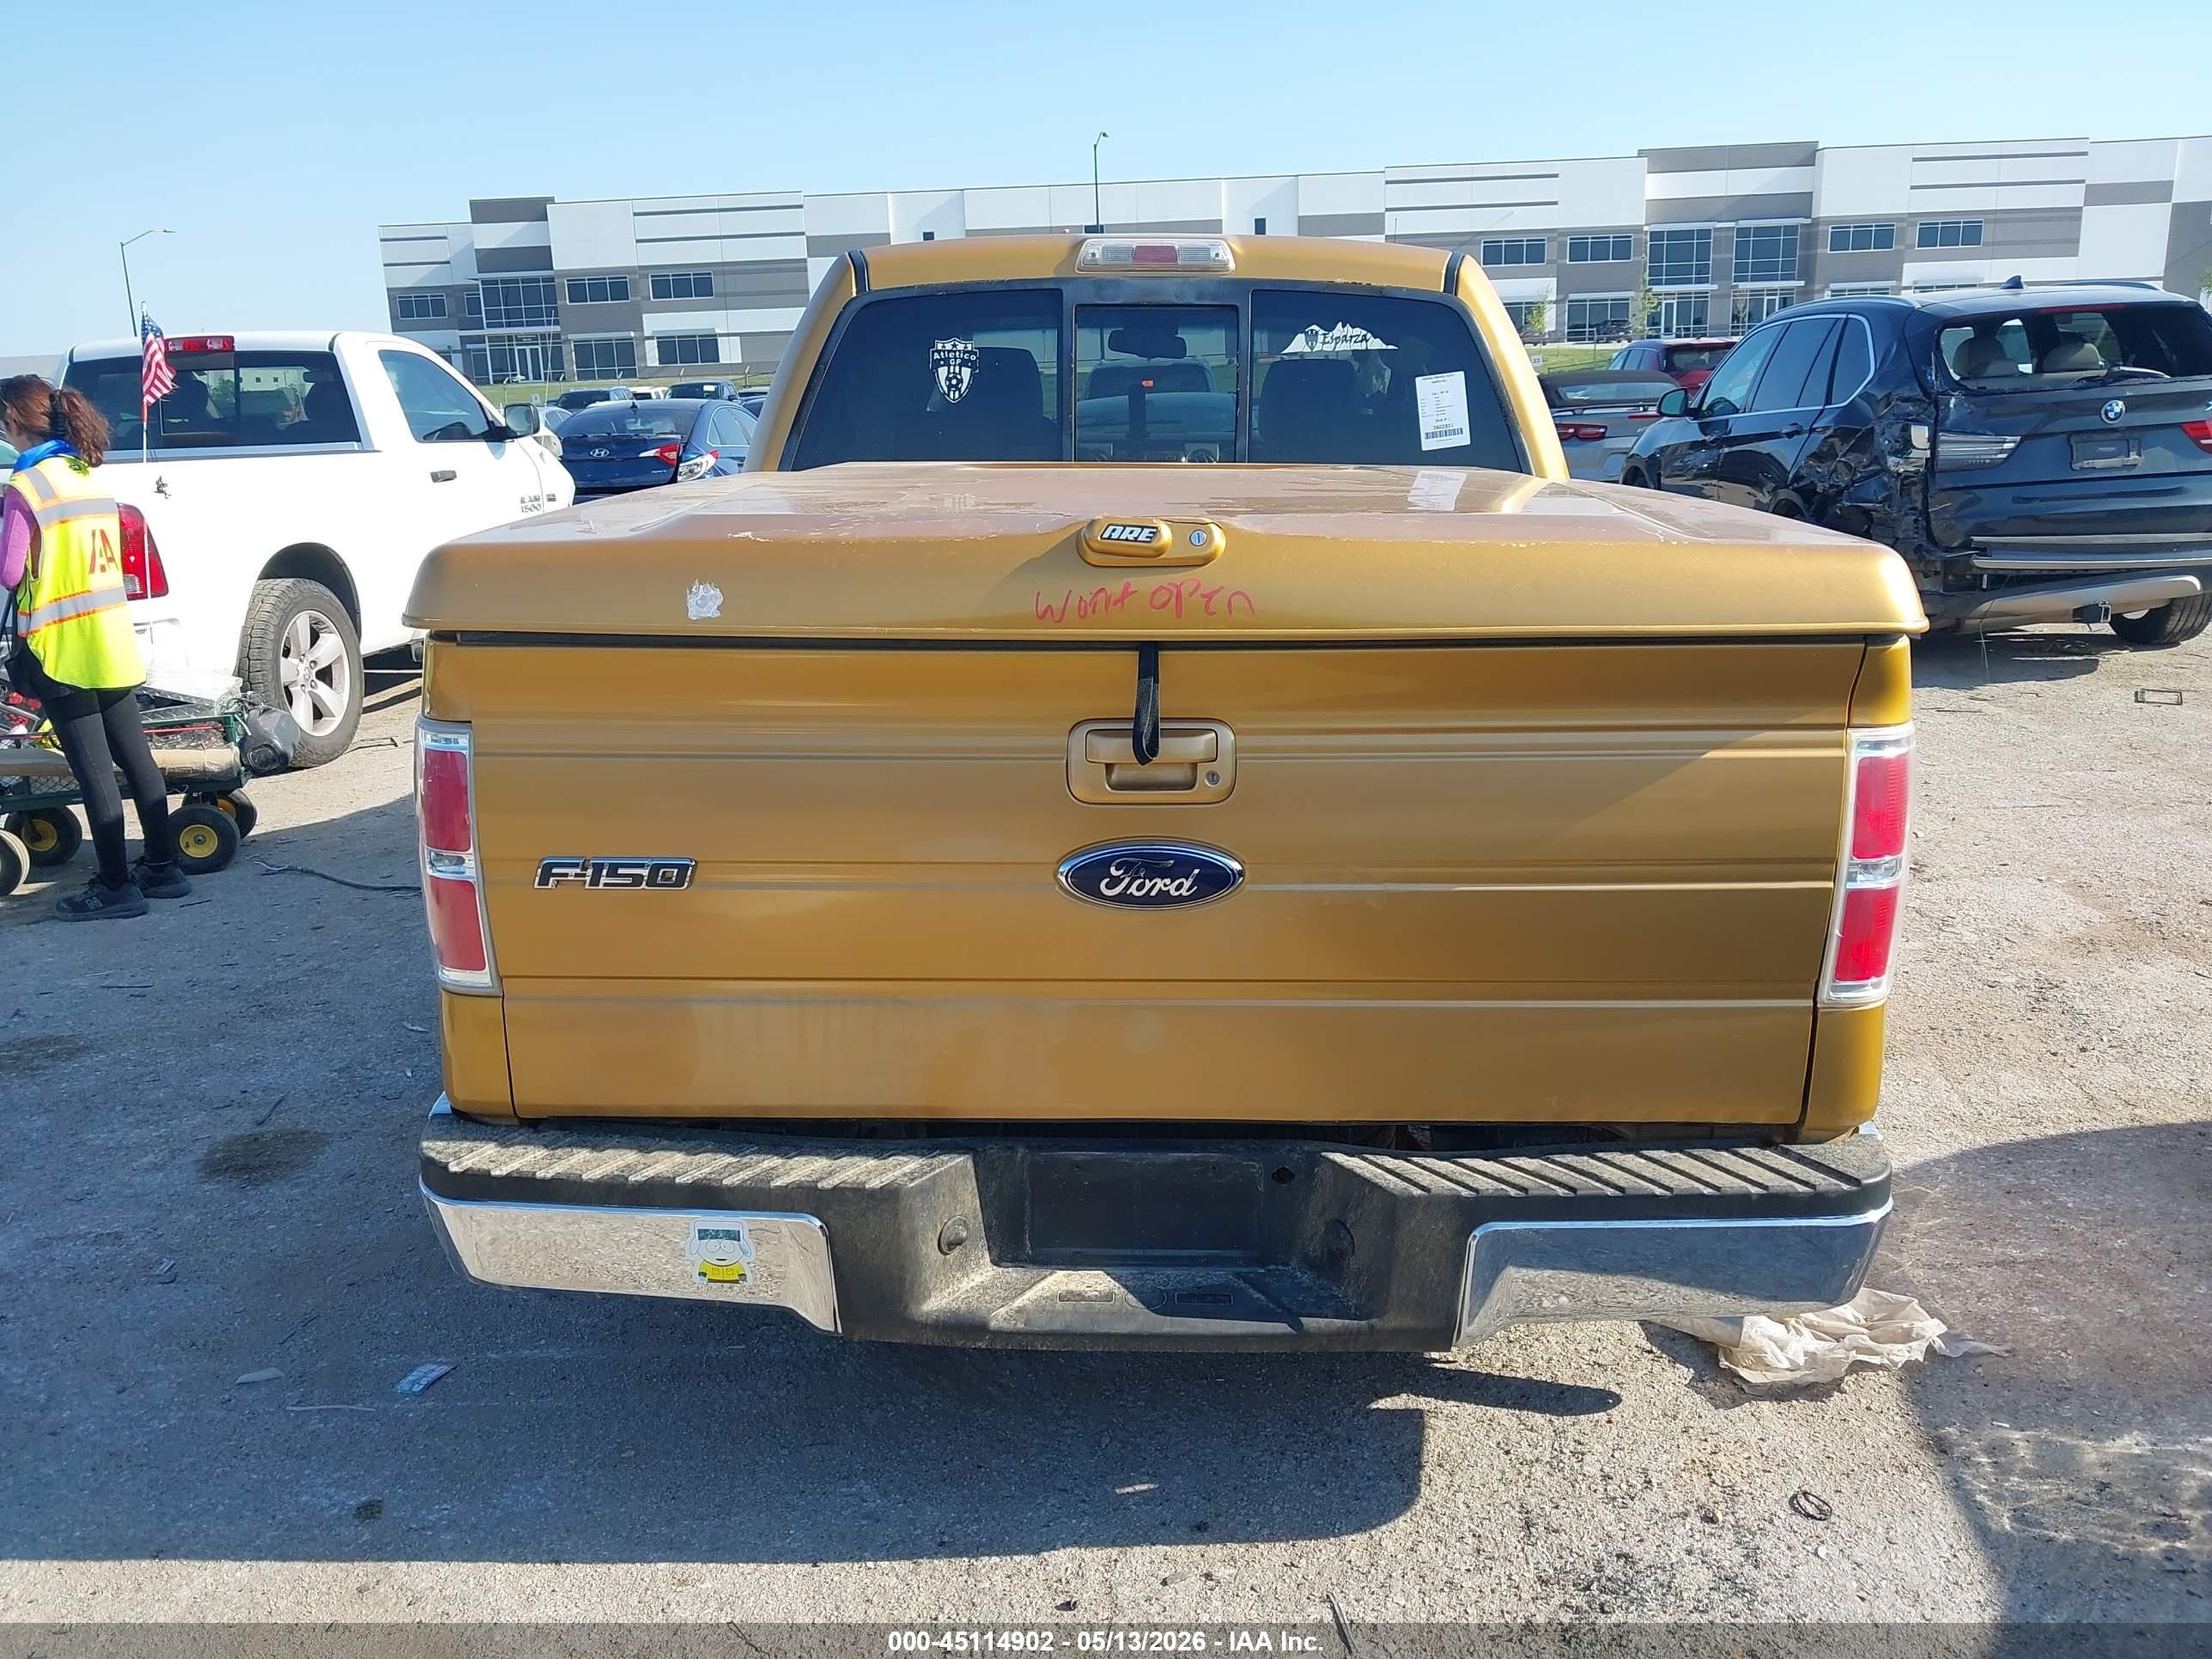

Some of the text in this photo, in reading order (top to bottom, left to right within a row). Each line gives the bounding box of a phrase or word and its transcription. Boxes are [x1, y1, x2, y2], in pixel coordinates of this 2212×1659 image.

[1322, 332, 1370, 345] Esparza
[933, 350, 976, 361] Atletico
[1101, 524, 1160, 543] ARE
[533, 856, 697, 890] F-150
[1099, 857, 1200, 896] Ford
